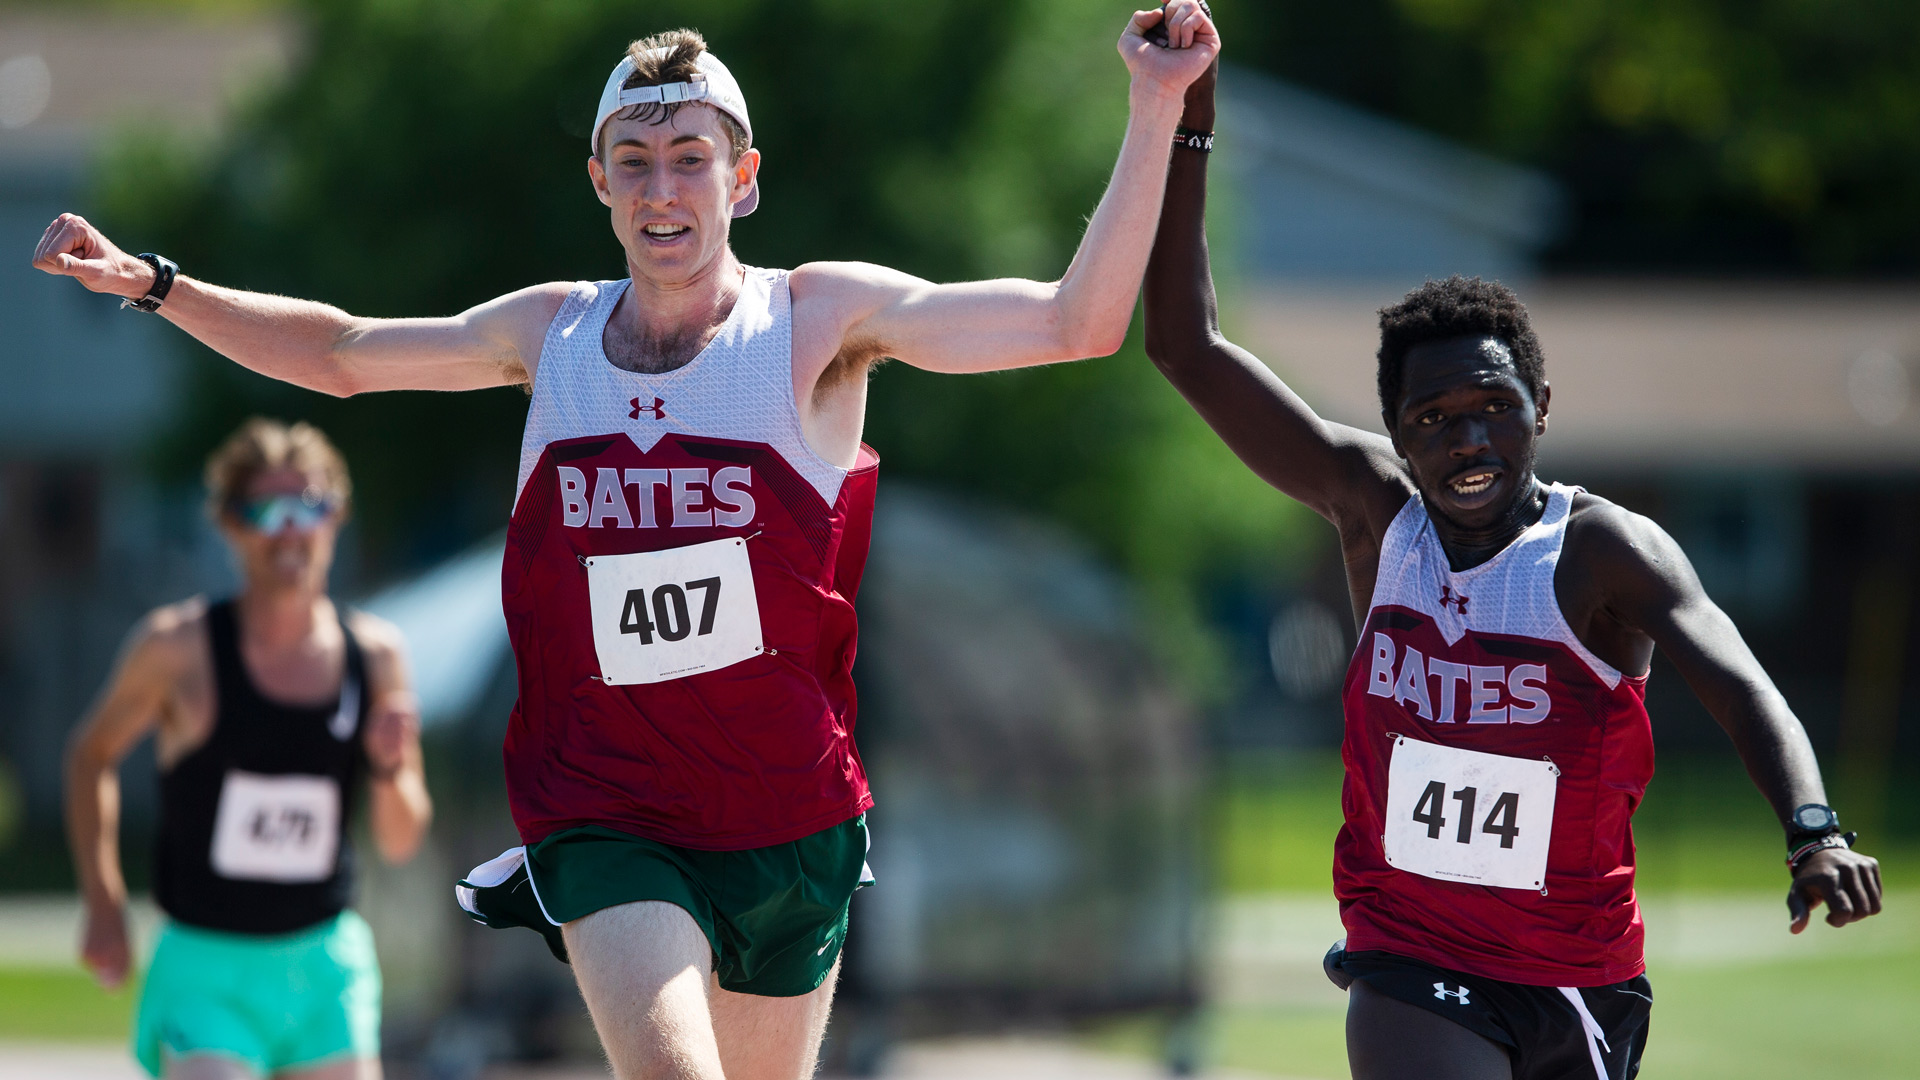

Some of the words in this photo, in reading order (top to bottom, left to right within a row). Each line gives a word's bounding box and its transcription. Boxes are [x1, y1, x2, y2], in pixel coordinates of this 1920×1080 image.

[556, 466, 756, 529] BATES
[619, 576, 722, 645] 407
[1366, 631, 1551, 725] BATES
[1412, 780, 1520, 850] 414
